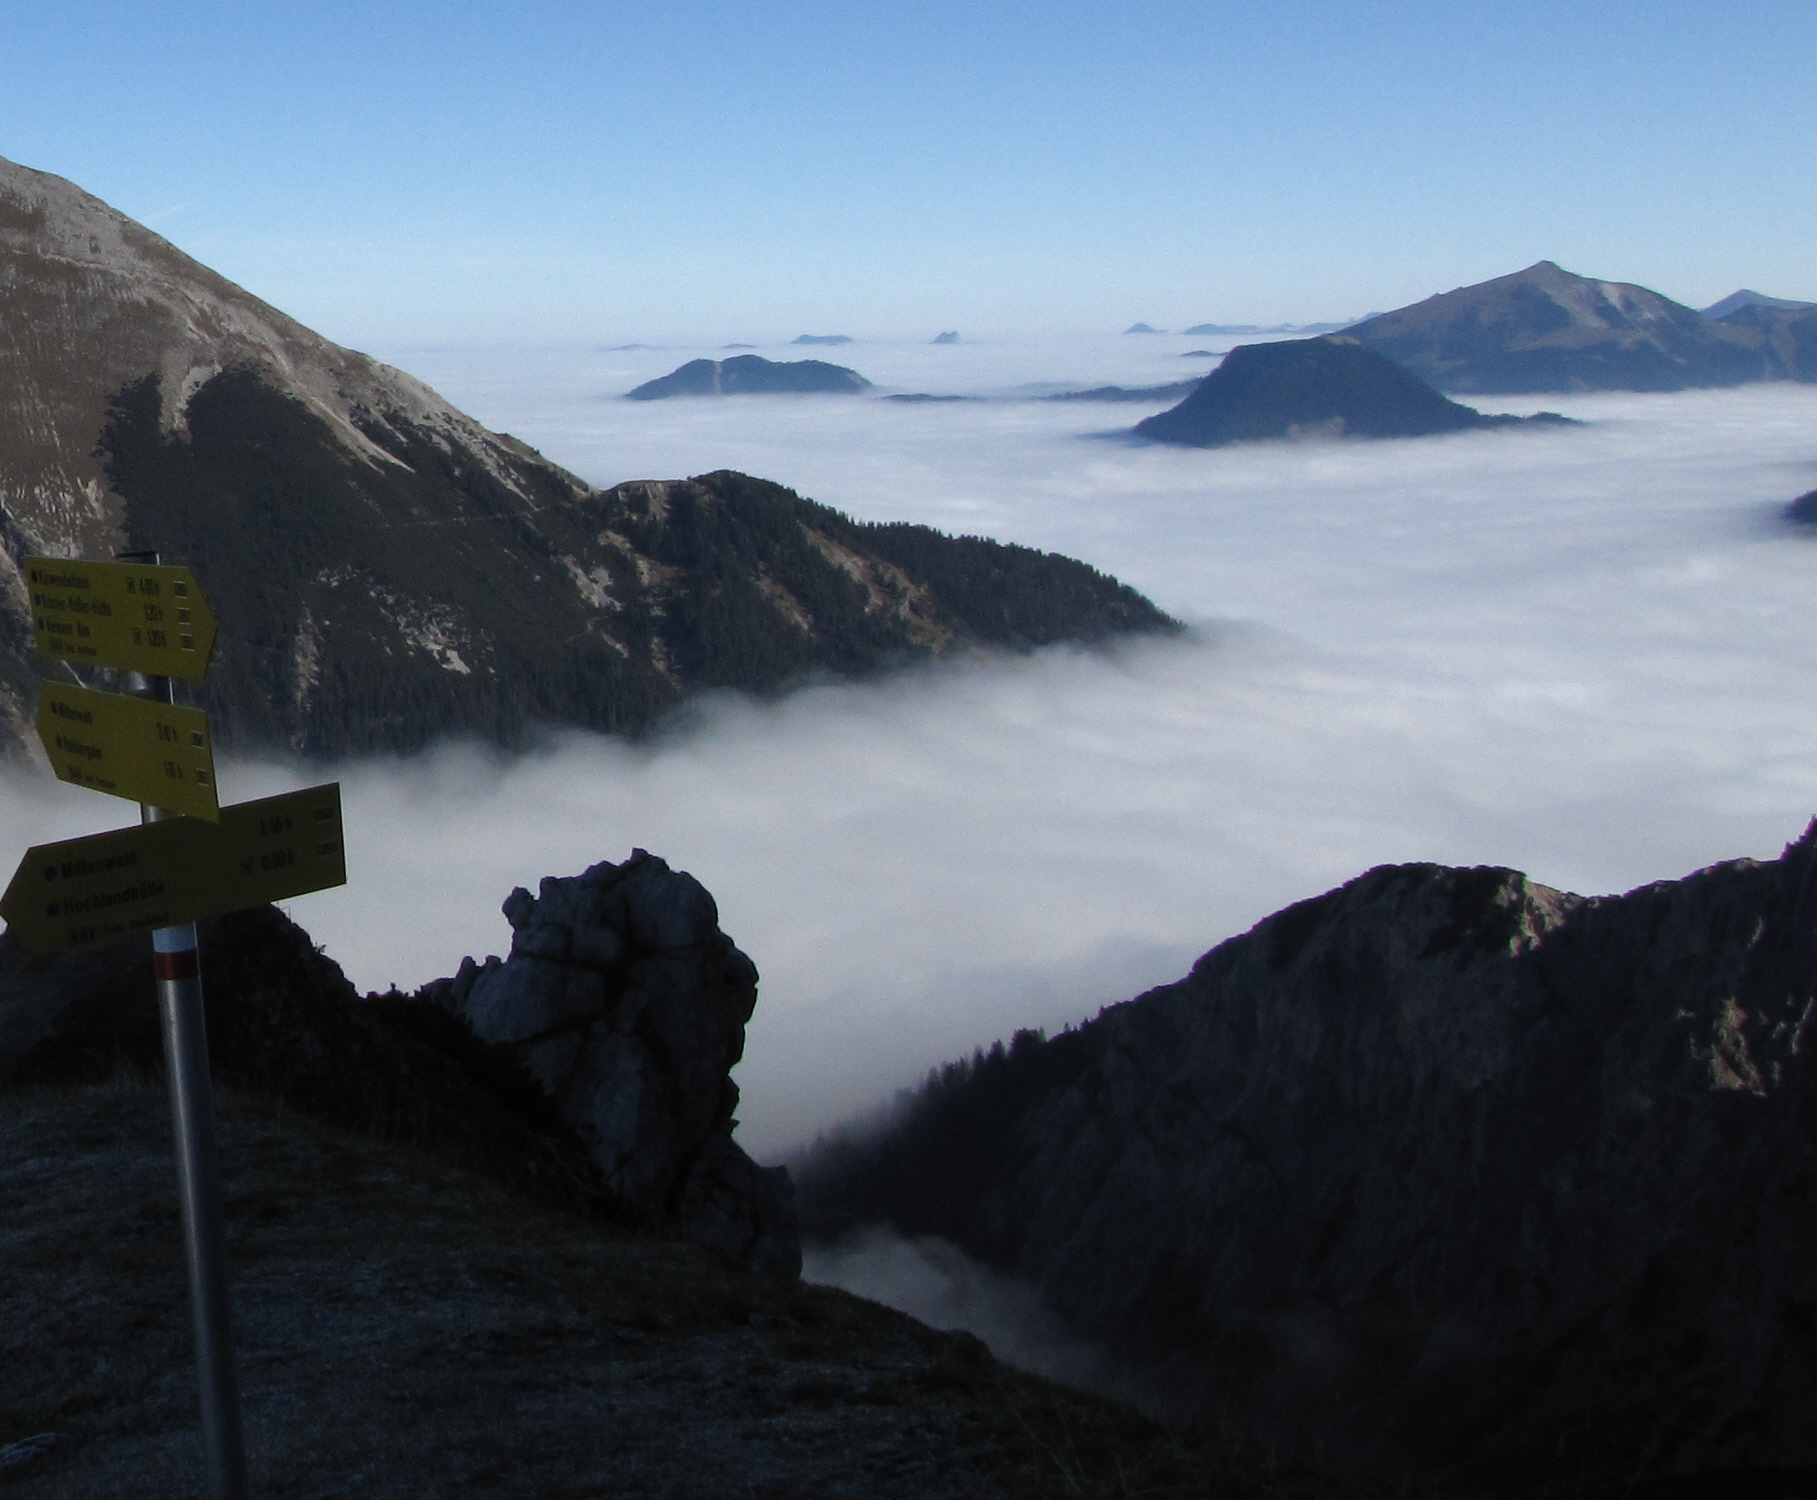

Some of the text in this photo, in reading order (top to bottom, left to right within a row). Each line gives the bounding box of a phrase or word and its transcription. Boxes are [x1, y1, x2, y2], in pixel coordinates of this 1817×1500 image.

[284, 815, 293, 831] h
[61, 848, 136, 879] Mittenwald
[286, 851, 295, 867] h
[64, 881, 165, 915] Hochlandhütte
